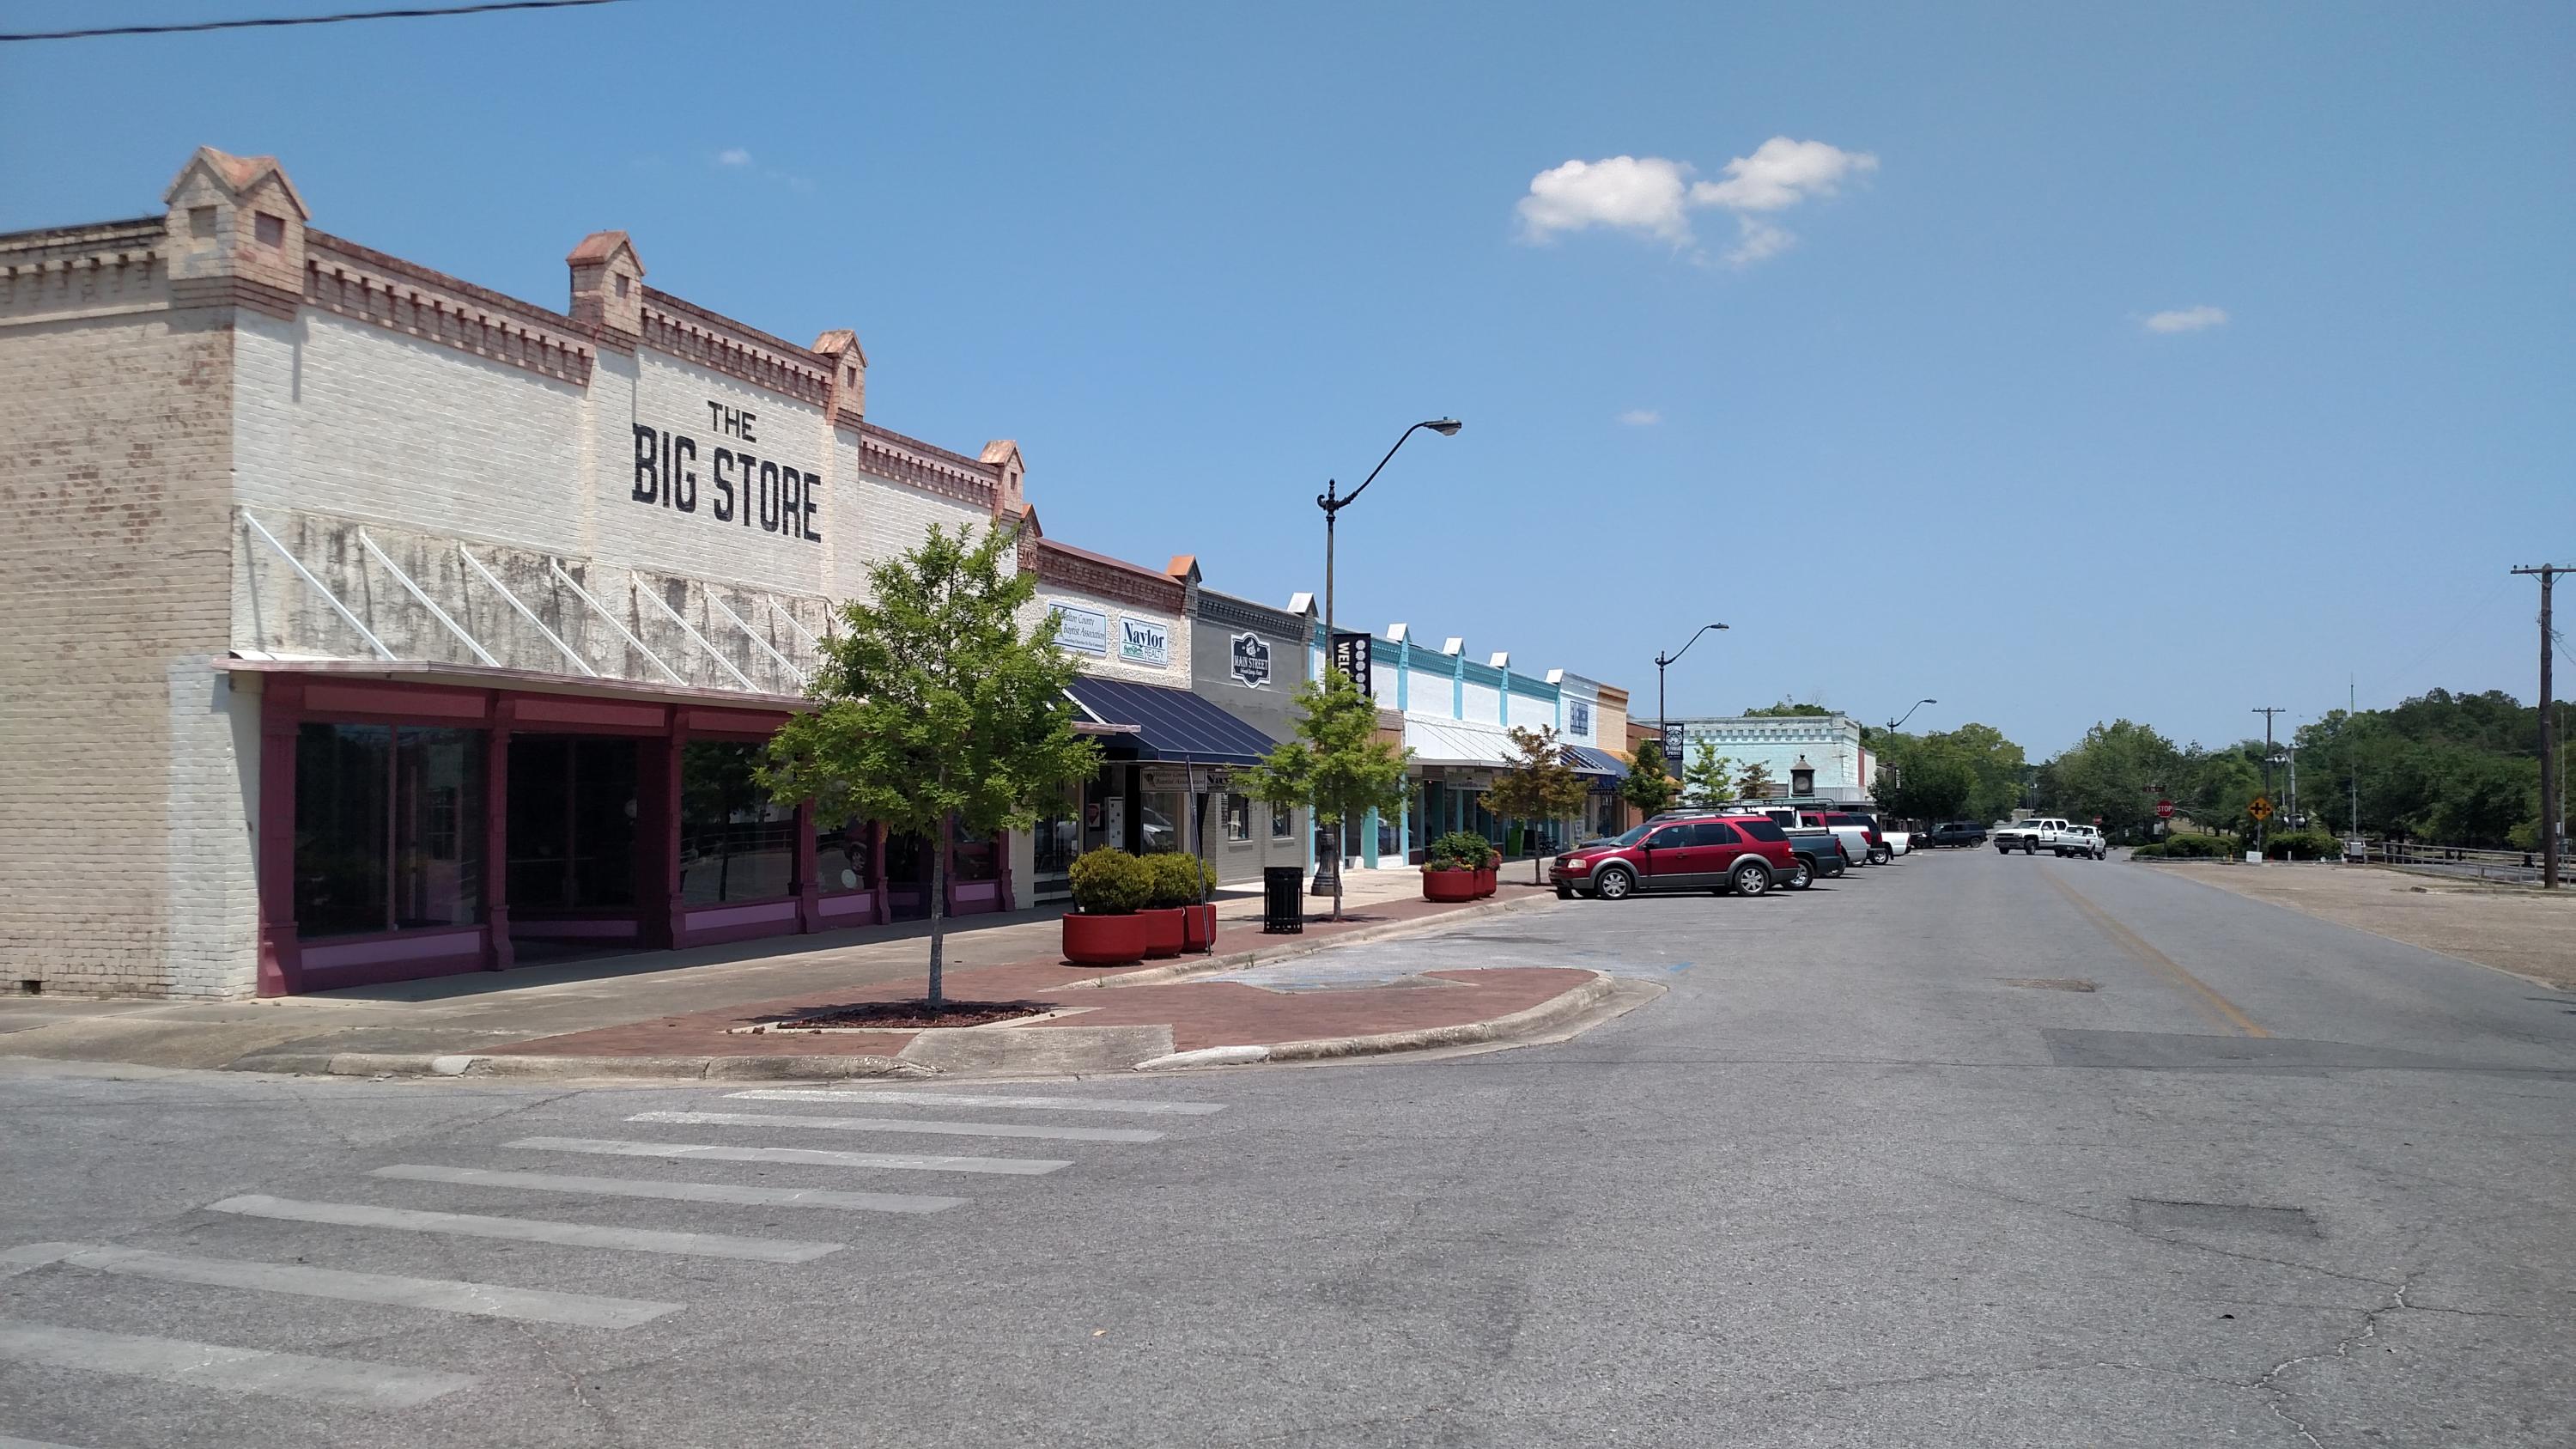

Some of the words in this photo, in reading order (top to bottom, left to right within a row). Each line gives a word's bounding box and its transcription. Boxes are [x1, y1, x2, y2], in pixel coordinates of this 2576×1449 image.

[708, 400, 756, 443] THE
[632, 423, 696, 514] BIG
[714, 447, 821, 543] STORE
[1123, 622, 1164, 648] Naylor
[1145, 648, 1164, 659] REALTY
[1234, 655, 1248, 667] MAIN
[1249, 658, 1268, 670] STREET
